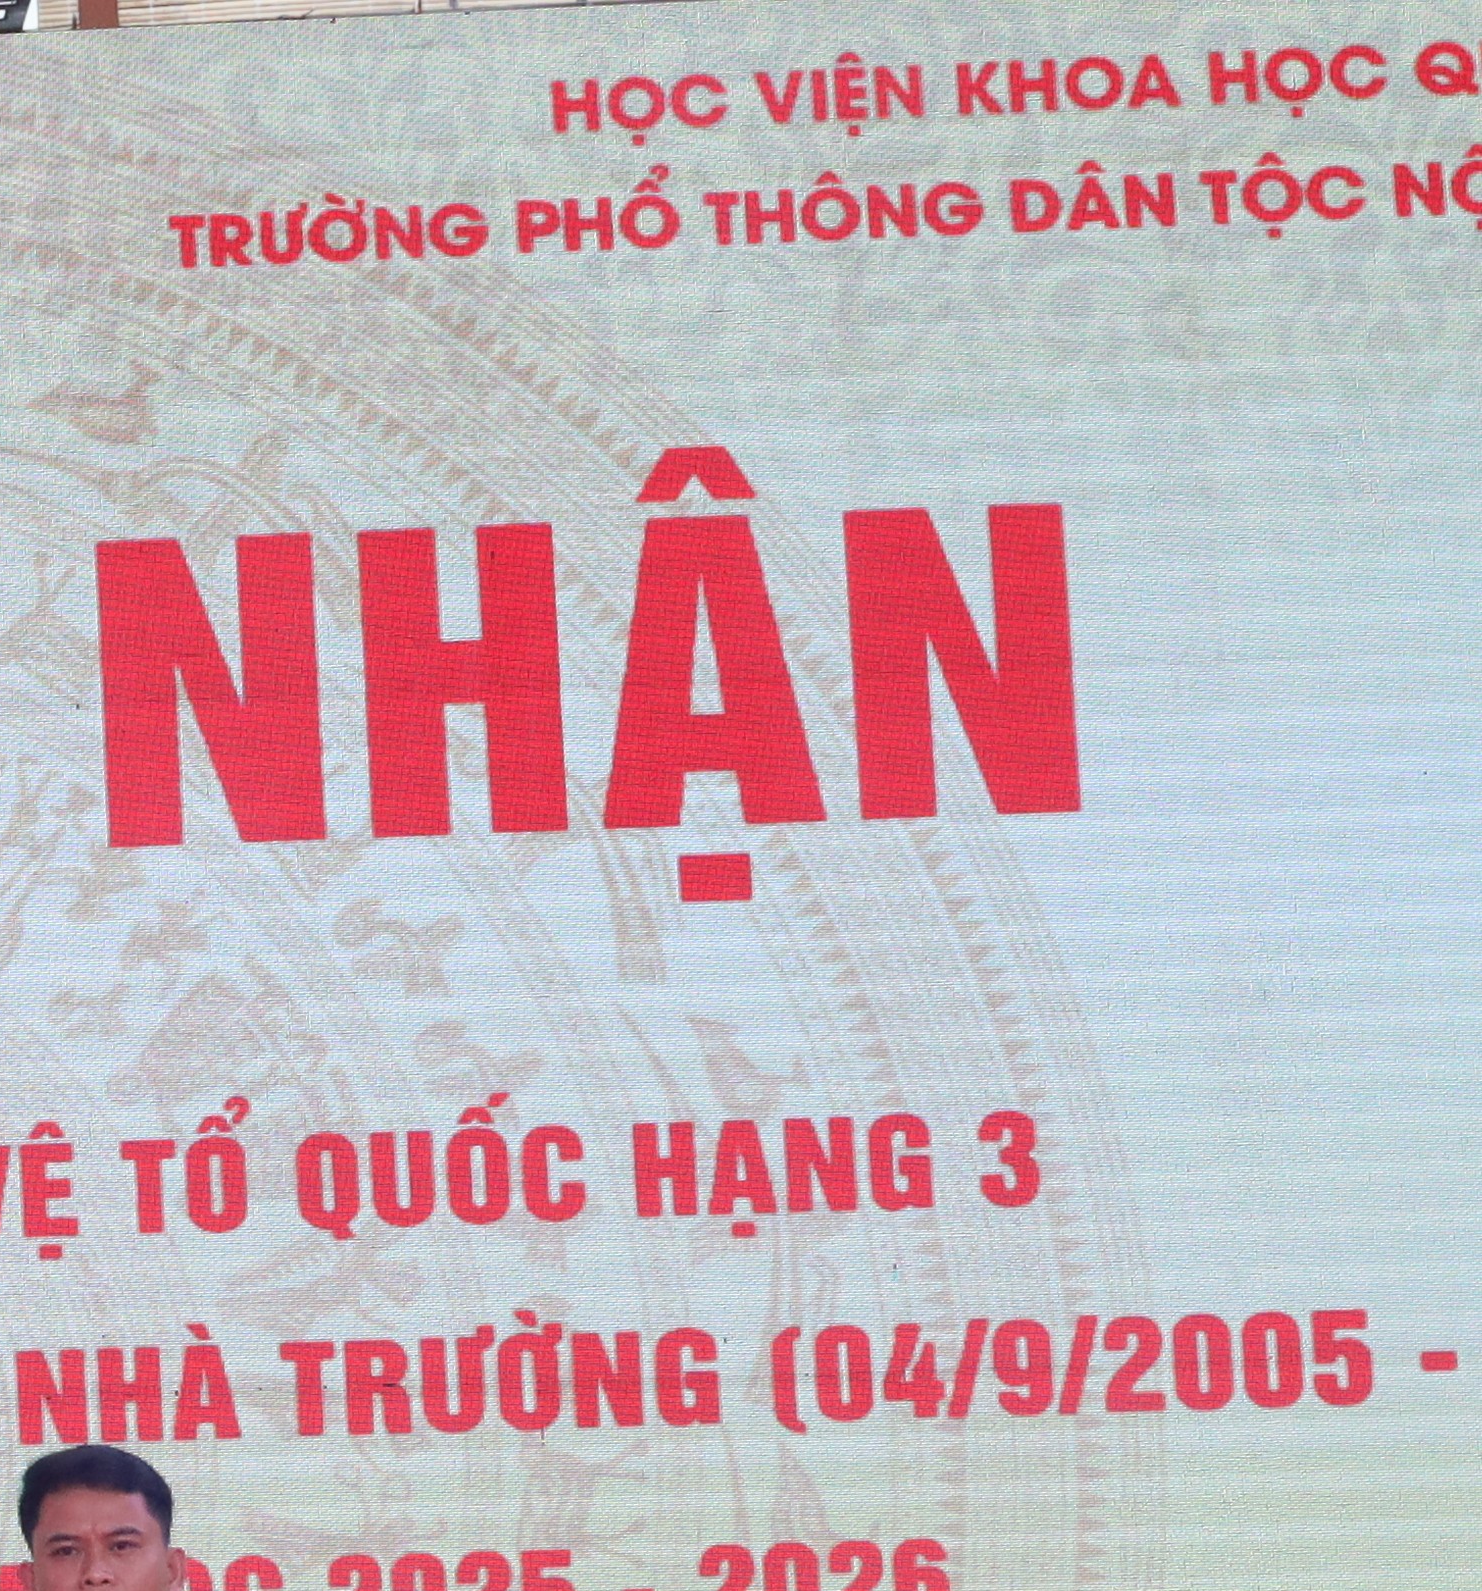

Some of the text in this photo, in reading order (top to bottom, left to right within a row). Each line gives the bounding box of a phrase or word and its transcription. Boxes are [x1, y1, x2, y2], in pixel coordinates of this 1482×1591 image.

[552, 41, 1482, 146] HỌC VIỆN KHOA HỌC Q
[169, 192, 489, 269] TRƯỜNG
[517, 165, 681, 254] PHỔ
[704, 171, 985, 245] THÔNG
[1010, 159, 1177, 234] DÂN
[1199, 152, 1366, 239] TỘC
[96, 445, 1081, 902] NHẬN
[121, 1096, 248, 1234] TỔ
[296, 1092, 586, 1240] QUỐC
[633, 1111, 934, 1238] HẠNG
[979, 1110, 1041, 1207] 3
[17, 1323, 241, 1445] NHÀ
[280, 1309, 721, 1436] TRƯỜNG
[772, 1308, 1374, 1433] (04/9/2005
[1421, 1351, 1458, 1372] -
